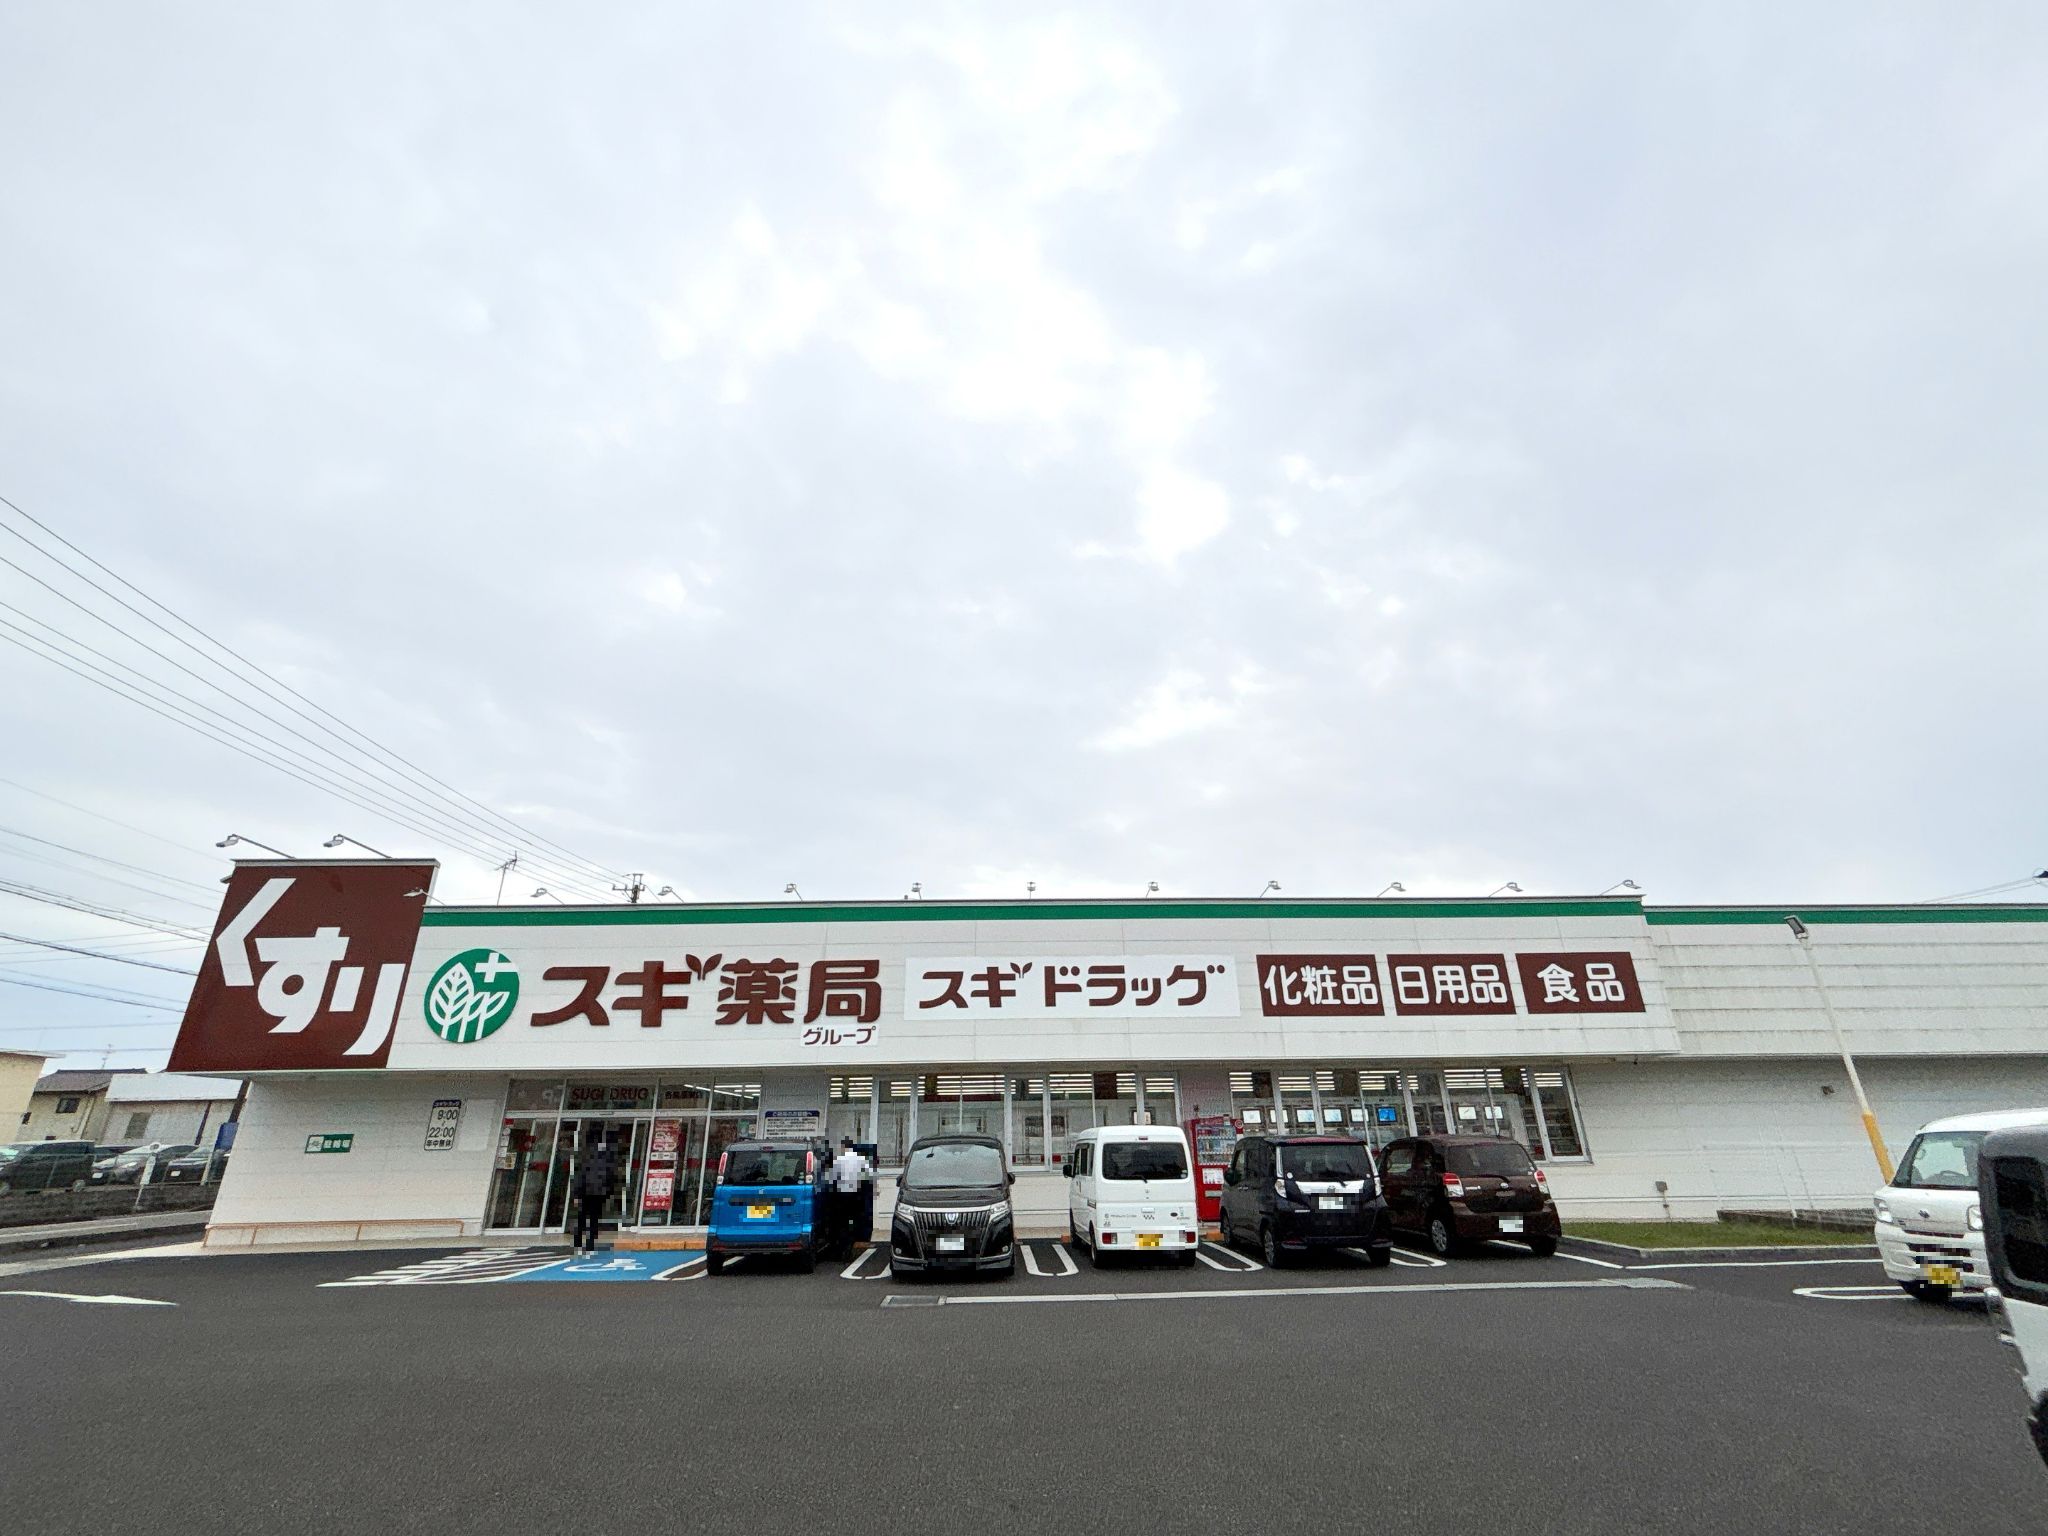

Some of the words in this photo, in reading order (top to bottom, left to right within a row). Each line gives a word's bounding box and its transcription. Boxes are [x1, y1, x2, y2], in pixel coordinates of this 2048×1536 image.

[216, 878, 405, 1056] くすり
[1264, 965, 1376, 1006] 化粧品
[1395, 965, 1508, 1005] 日用品
[1537, 963, 1626, 1004] 食品
[531, 954, 881, 1028] スギ薬局
[803, 1025, 877, 1046] グループ
[571, 1087, 604, 1101] SUGI
[609, 1087, 649, 1101] DRUG
[428, 1127, 455, 1138] 22:00
[437, 1109, 458, 1120] 9:00
